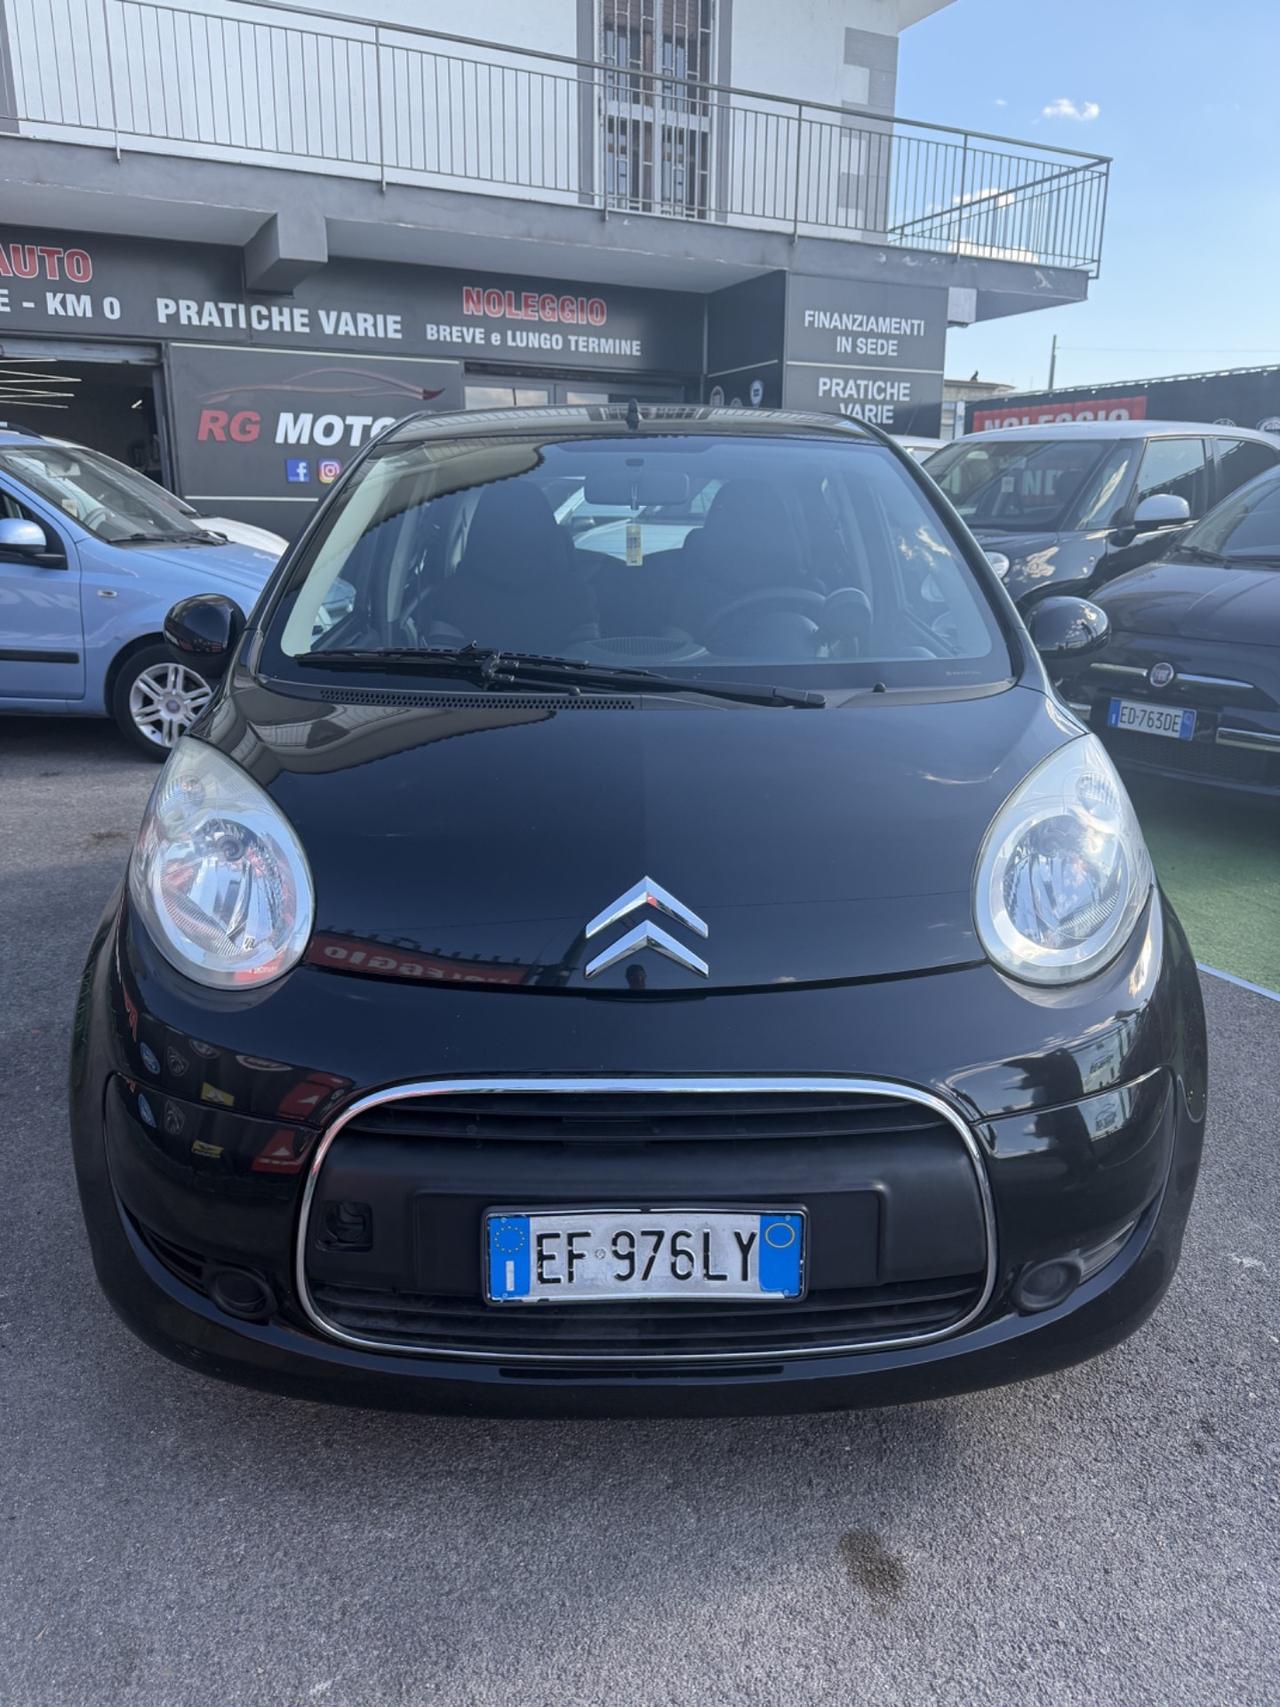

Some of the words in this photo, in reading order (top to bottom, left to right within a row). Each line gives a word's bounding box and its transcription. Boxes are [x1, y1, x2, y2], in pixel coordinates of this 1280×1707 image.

[46, 292, 93, 318] KM
[156, 297, 310, 333] PRATICHE
[318, 310, 402, 339] VARIE
[462, 286, 607, 326] NOLEGGIO
[804, 310, 925, 337] FINANZIAMENTI
[426, 323, 485, 345] BREVE
[491, 331, 501, 346] e
[506, 330, 563, 350] LUNGO
[568, 335, 642, 356] TERMINE
[836, 335, 852, 353] IN
[856, 338, 898, 356] SEDE
[818, 377, 911, 402] PRATICHE
[197, 410, 261, 443] RG
[839, 403, 894, 424] VARIE
[536, 1231, 592, 1284] EF
[611, 1229, 758, 1282] 976LY
